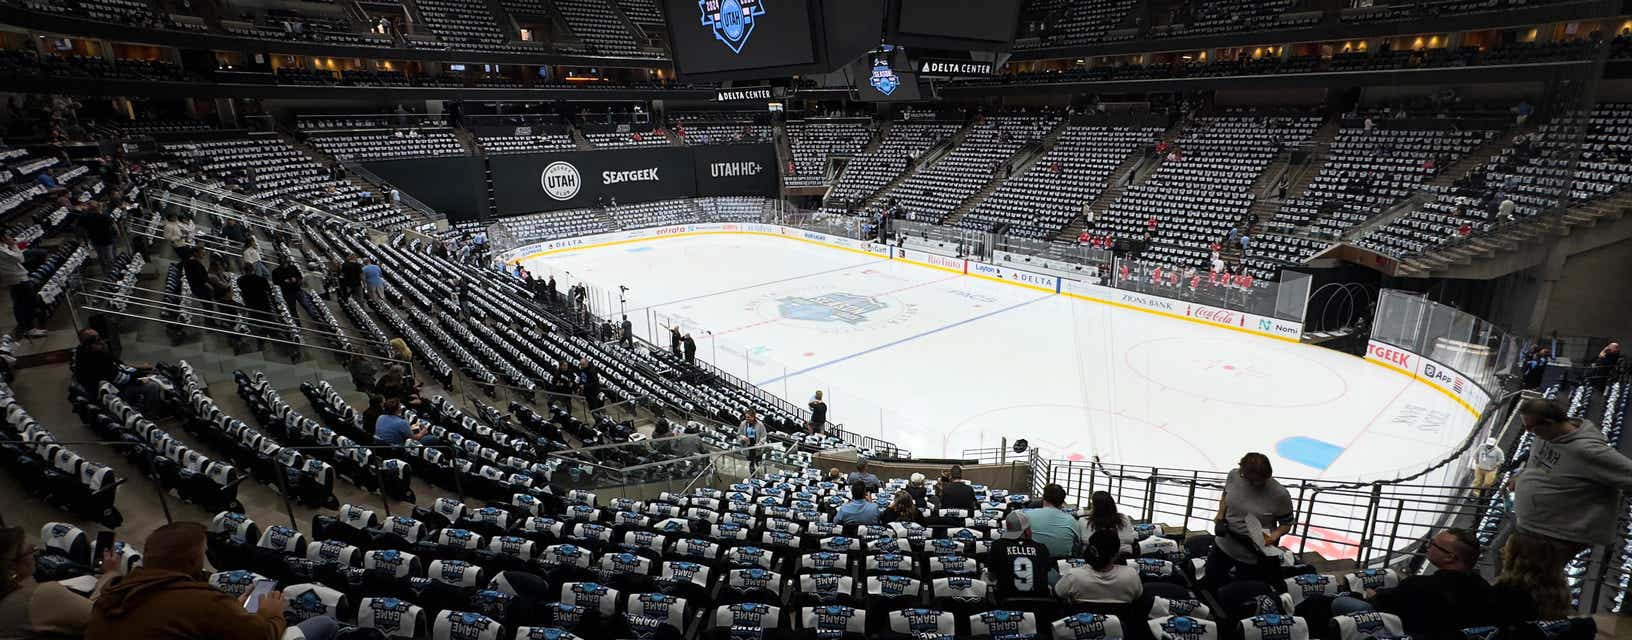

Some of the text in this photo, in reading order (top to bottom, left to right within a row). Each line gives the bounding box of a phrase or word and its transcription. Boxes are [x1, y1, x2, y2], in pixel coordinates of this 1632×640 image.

[723, 11, 741, 27] UTAH
[931, 63, 990, 74] DELTA CENTER
[723, 90, 770, 100] DELTA CENTER
[711, 161, 763, 178] UTAH HC+
[548, 174, 576, 189] UTAH
[602, 167, 660, 185] SEATGEEK
[656, 226, 686, 236] entrata
[556, 239, 583, 249] DELTA
[975, 263, 995, 273] Layton
[1021, 273, 1051, 286] DELTA
[1122, 294, 1173, 311] ZIONS BANK
[1275, 324, 1298, 334] Nomi
[1367, 344, 1410, 369] TGEEK
[1006, 546, 1037, 557] KELLER
[1013, 556, 1034, 592] 9
[819, 614, 846, 626] GAME
[909, 615, 936, 625] GAME
